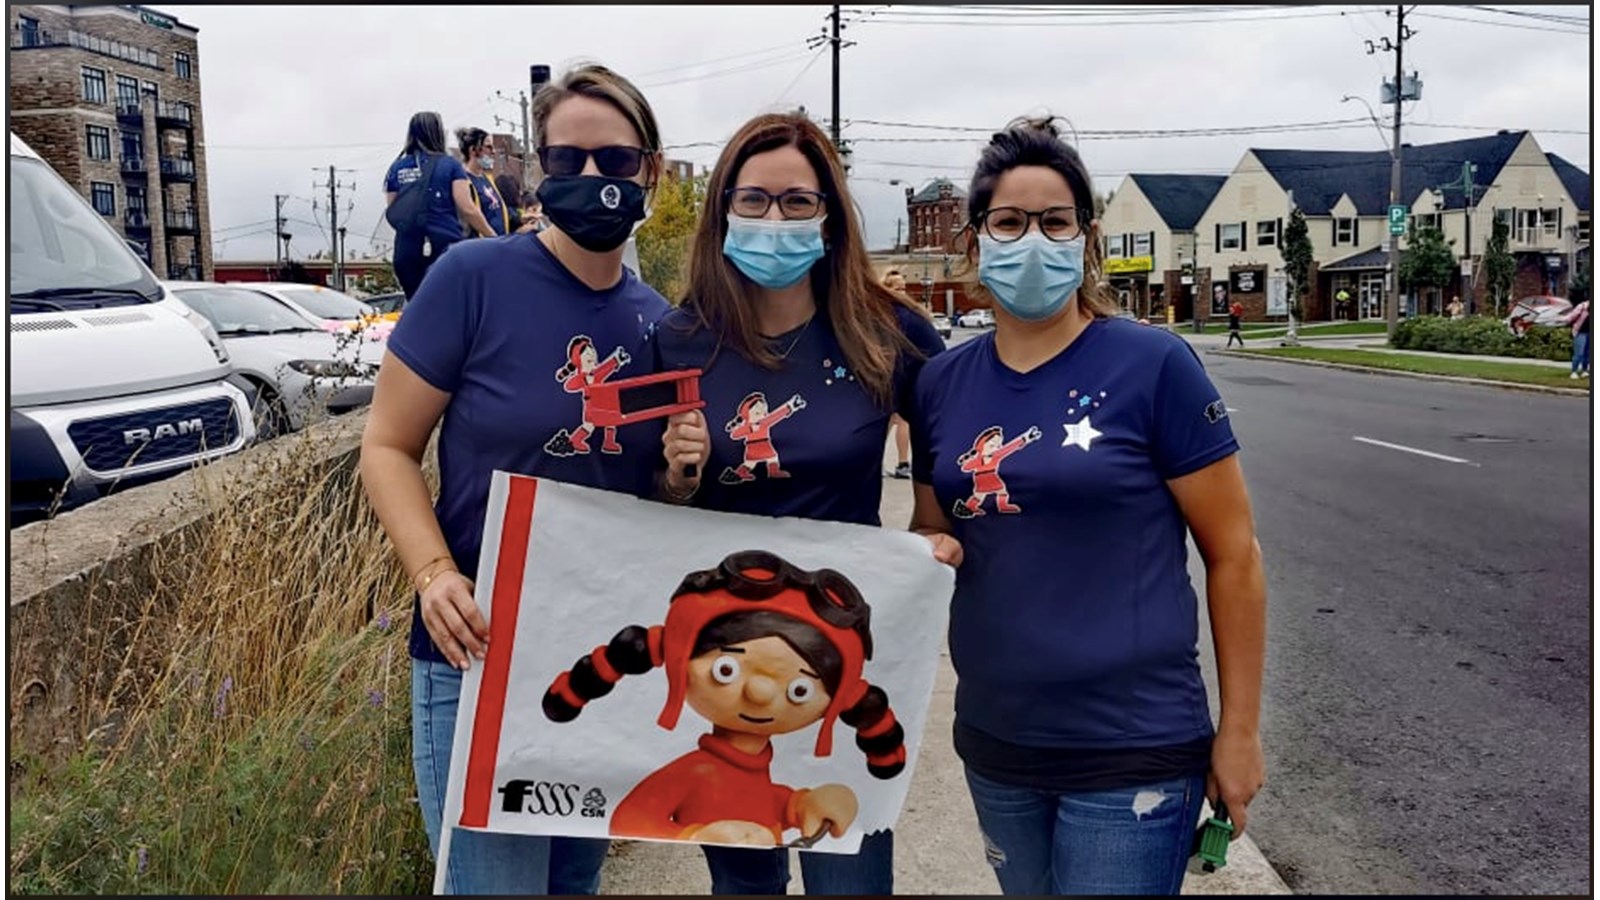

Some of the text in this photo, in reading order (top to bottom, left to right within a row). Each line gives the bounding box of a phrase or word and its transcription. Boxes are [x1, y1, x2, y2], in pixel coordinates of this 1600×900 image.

[1392, 208, 1402, 221] P
[123, 418, 203, 445] RAM
[580, 808, 606, 818] CSN
